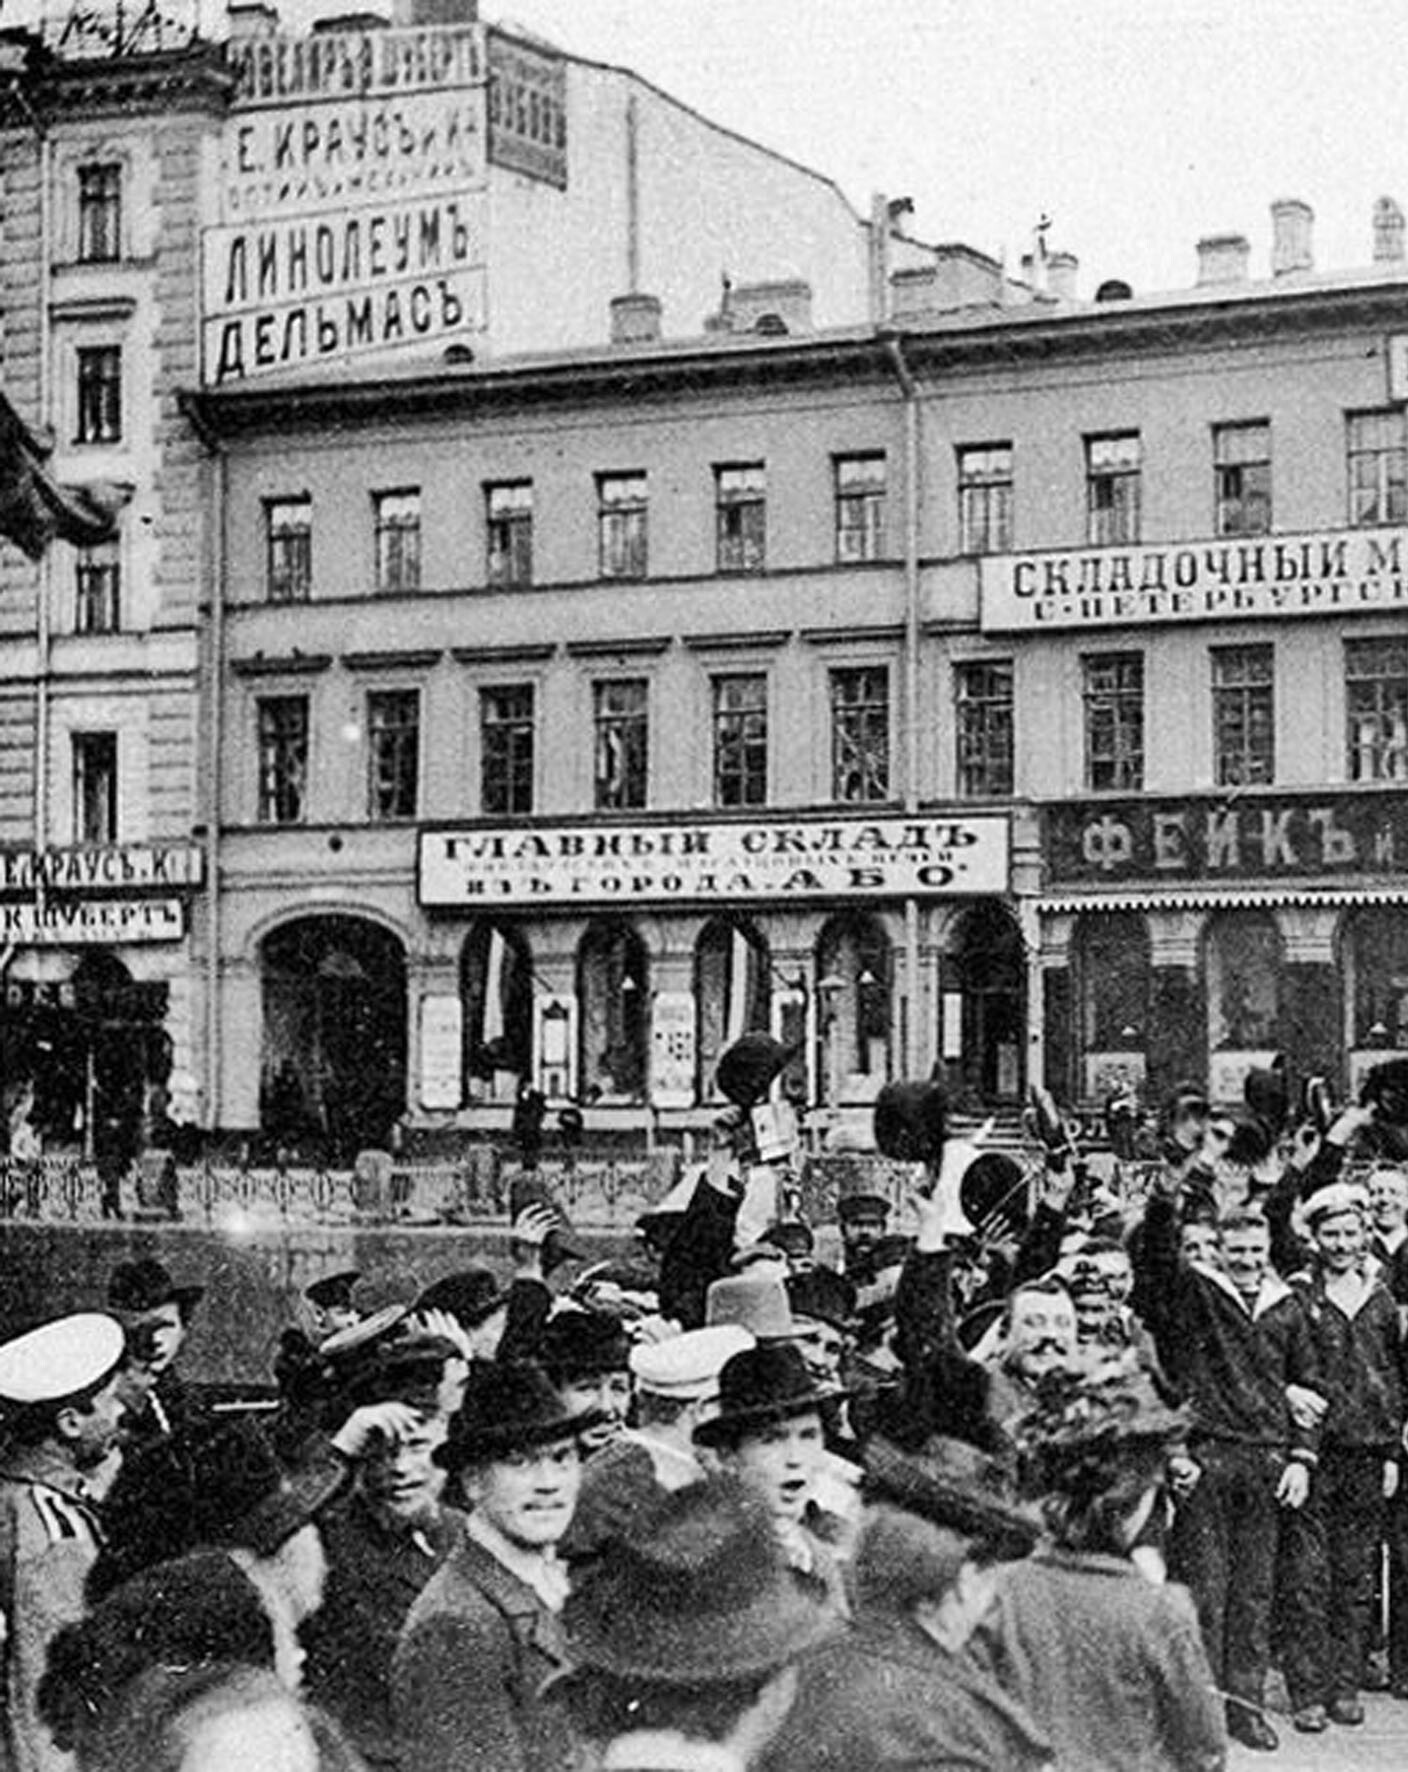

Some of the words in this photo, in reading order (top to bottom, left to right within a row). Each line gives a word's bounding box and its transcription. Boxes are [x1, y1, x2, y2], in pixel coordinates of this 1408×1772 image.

[274, 112, 416, 170] КРАУСЪ
[226, 205, 469, 303] ЛИНОЛЕУМЪ
[216, 280, 464, 386] ДЕЛЬМАСЪ
[741, 824, 978, 854] СКЛАДЪ
